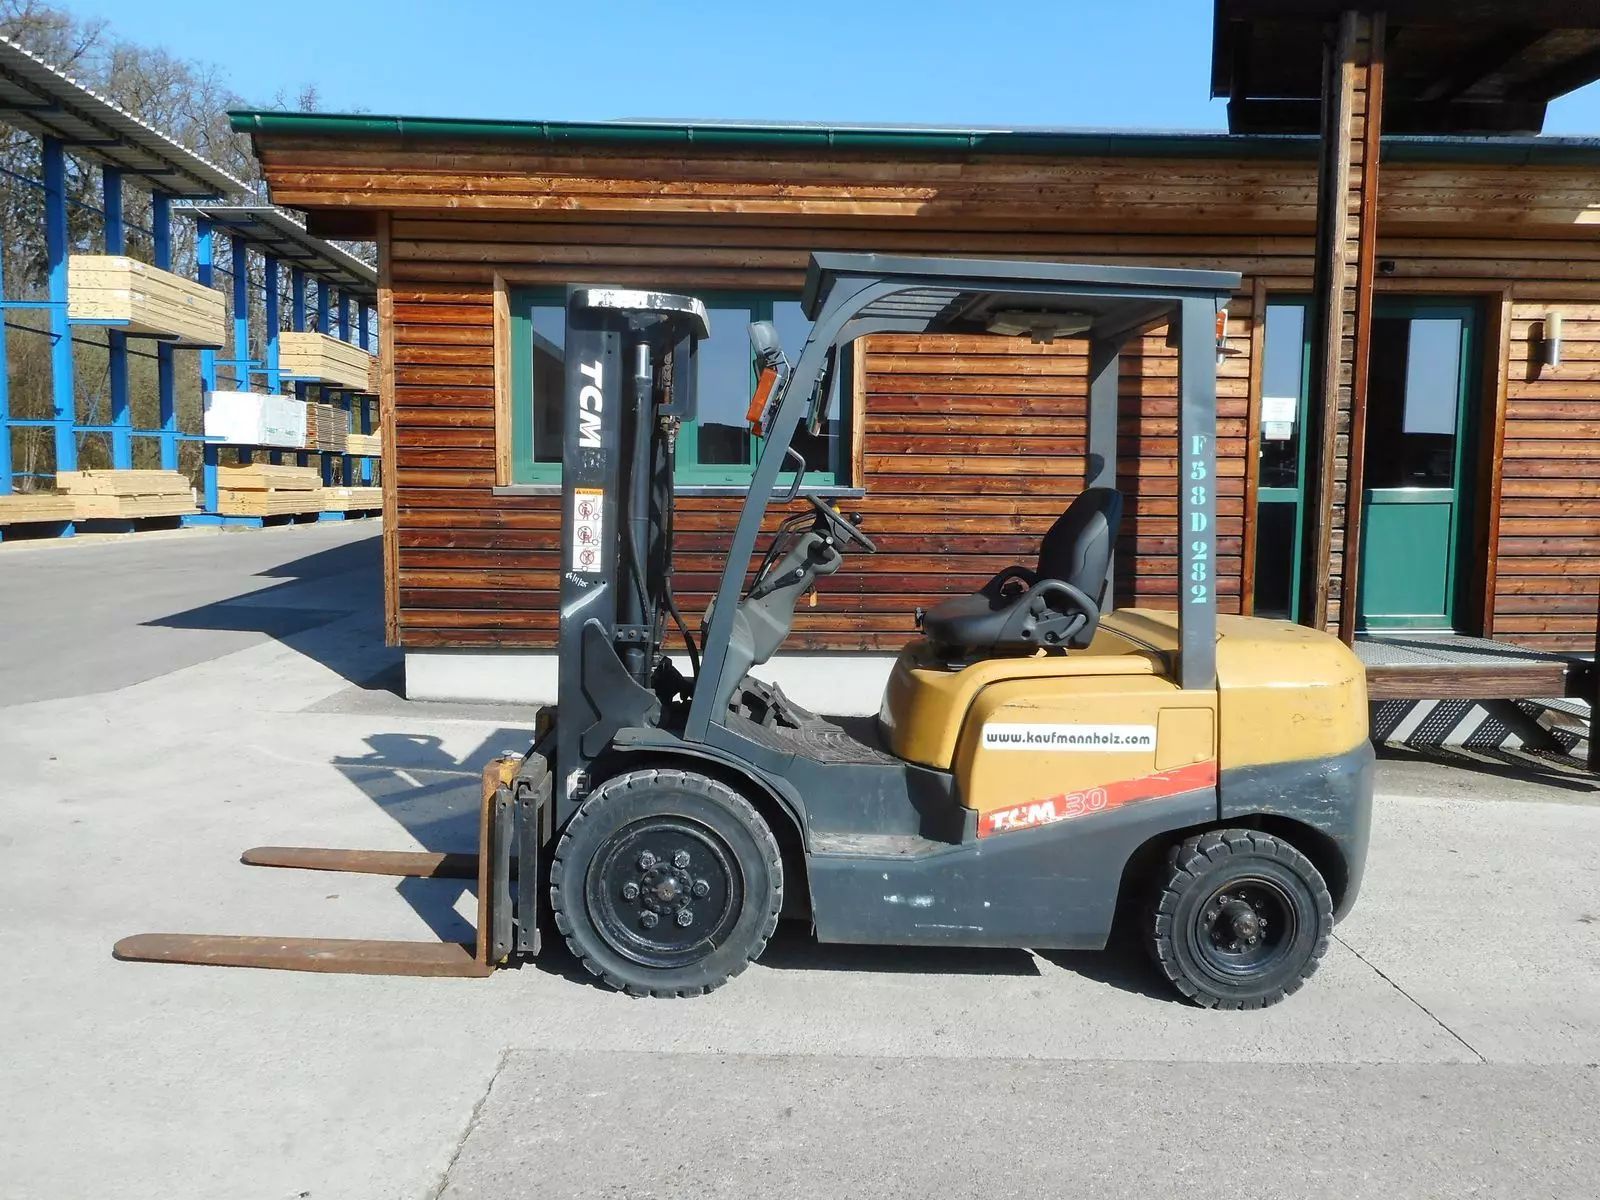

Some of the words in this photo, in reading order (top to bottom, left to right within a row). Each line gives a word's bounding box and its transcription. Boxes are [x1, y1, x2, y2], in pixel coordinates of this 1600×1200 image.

[579, 360, 603, 448] TCM
[986, 731, 1150, 746] www.kaufmannholz.com
[989, 801, 1056, 830] TCM
[1064, 788, 1107, 817] 30
